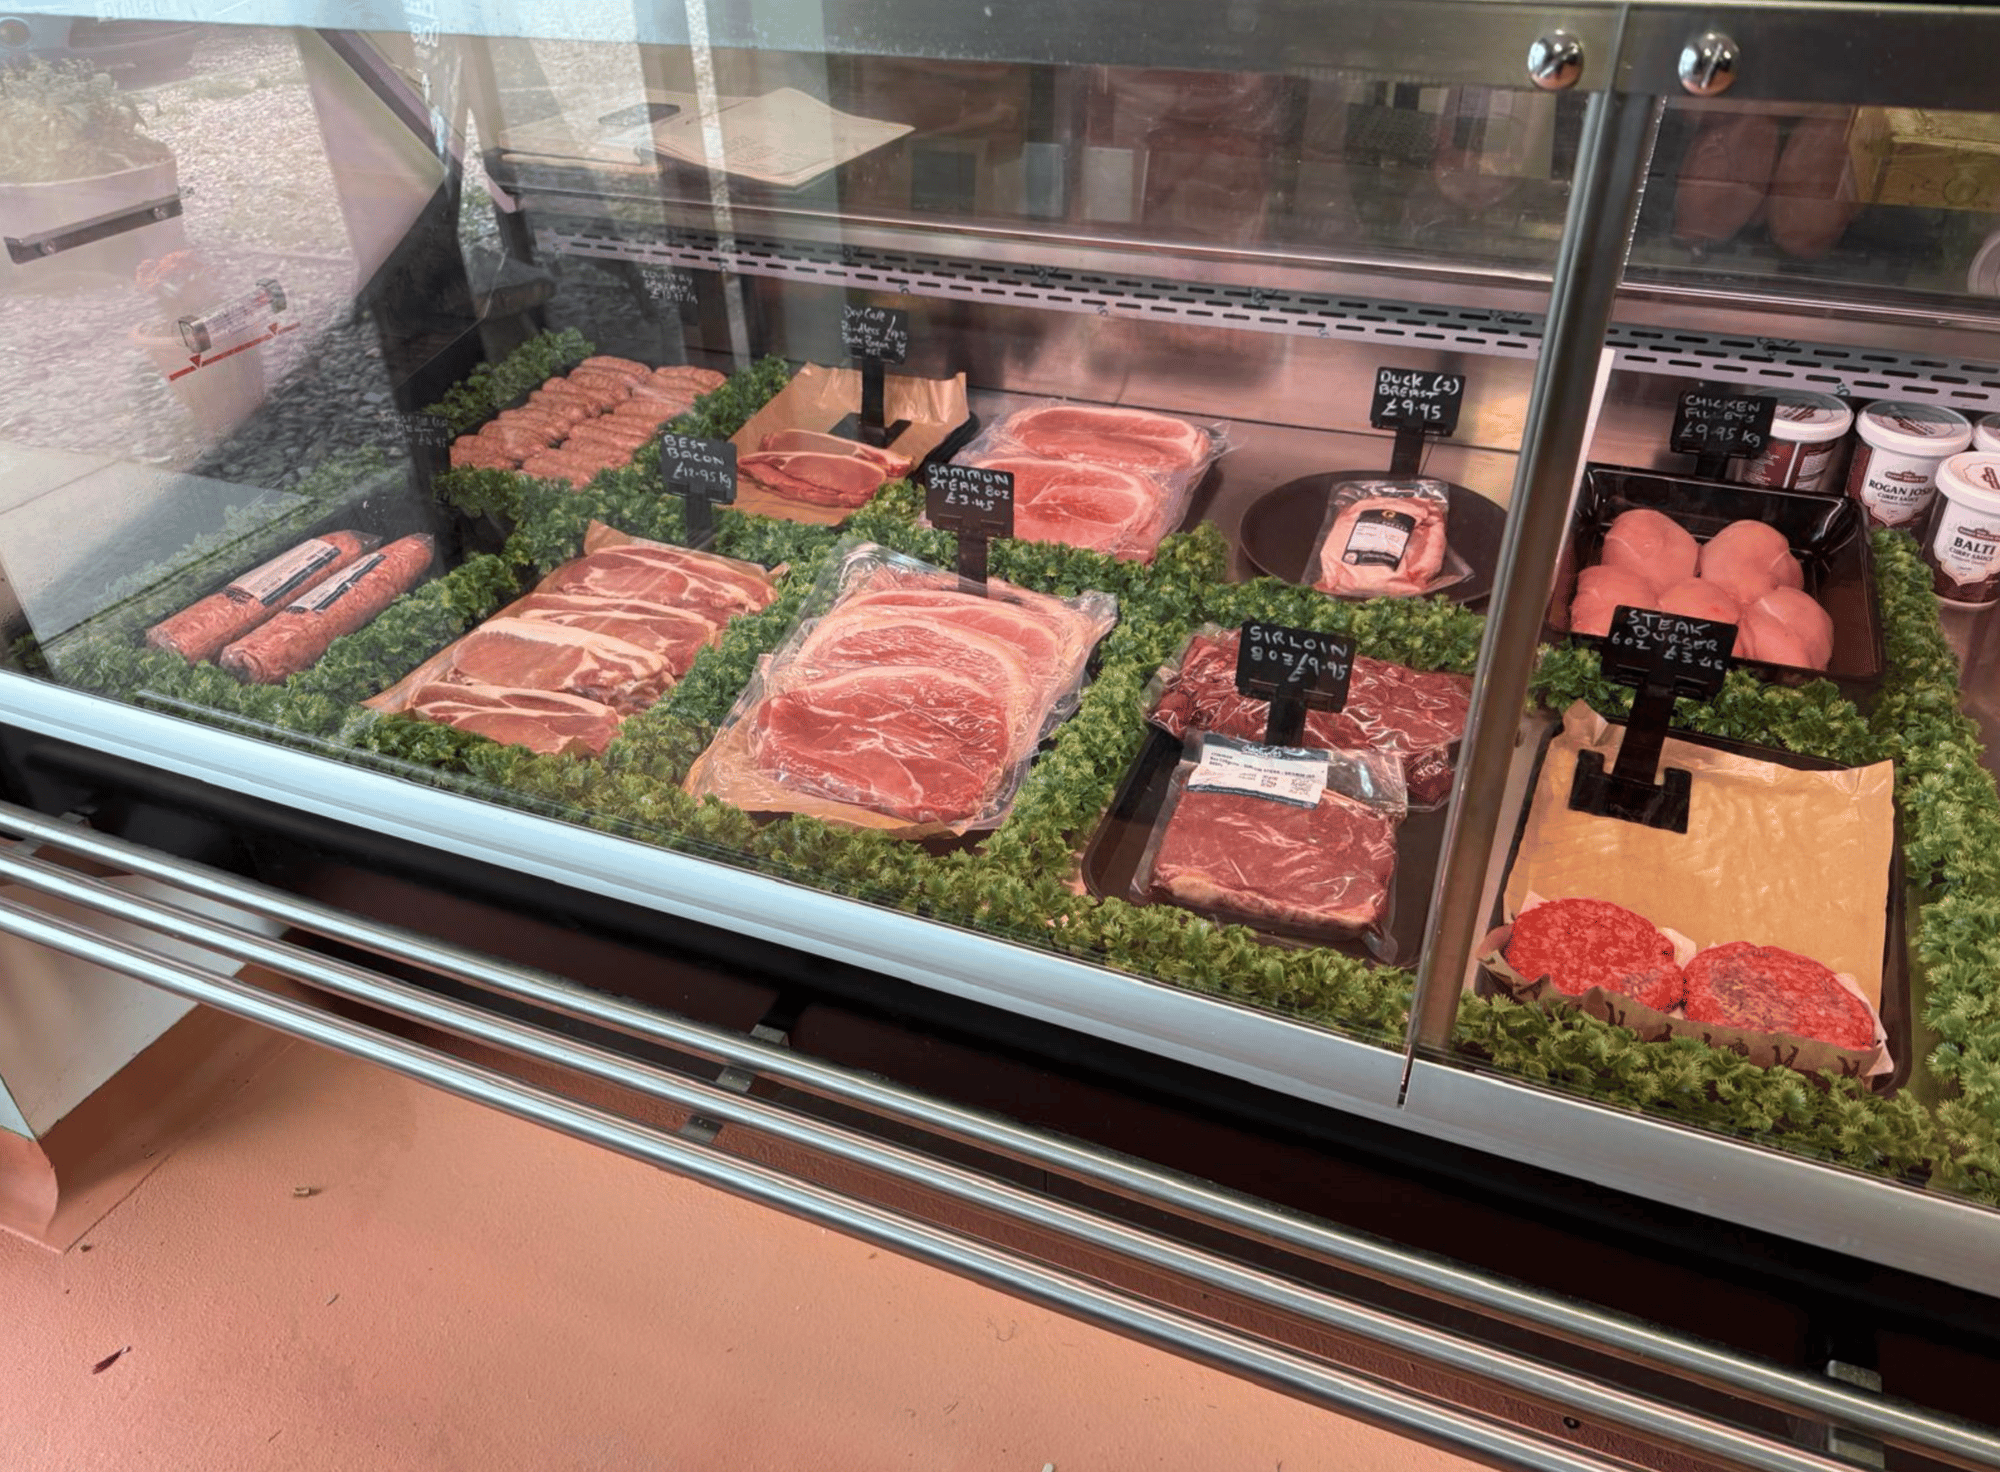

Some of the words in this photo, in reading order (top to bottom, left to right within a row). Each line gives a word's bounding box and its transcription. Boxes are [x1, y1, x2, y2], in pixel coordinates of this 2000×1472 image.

[1381, 398, 1442, 420] £9.95
[1685, 394, 1761, 413] CHICKEN
[1685, 407, 1755, 423] FILETS
[1680, 421, 1738, 441] £9.95
[664, 434, 707, 452] BEST
[666, 447, 725, 466] BACON
[672, 461, 717, 482] £12.95
[927, 464, 1009, 486] GAMMON
[929, 477, 980, 494] STEAK
[1868, 479, 1908, 495] ROGAN
[945, 491, 995, 512] £3.45
[1954, 536, 1997, 556] BALTI
[1627, 610, 1711, 636] STEAK
[1249, 625, 1348, 658] SIRLOIN
[1287, 653, 1349, 682] £9.95
